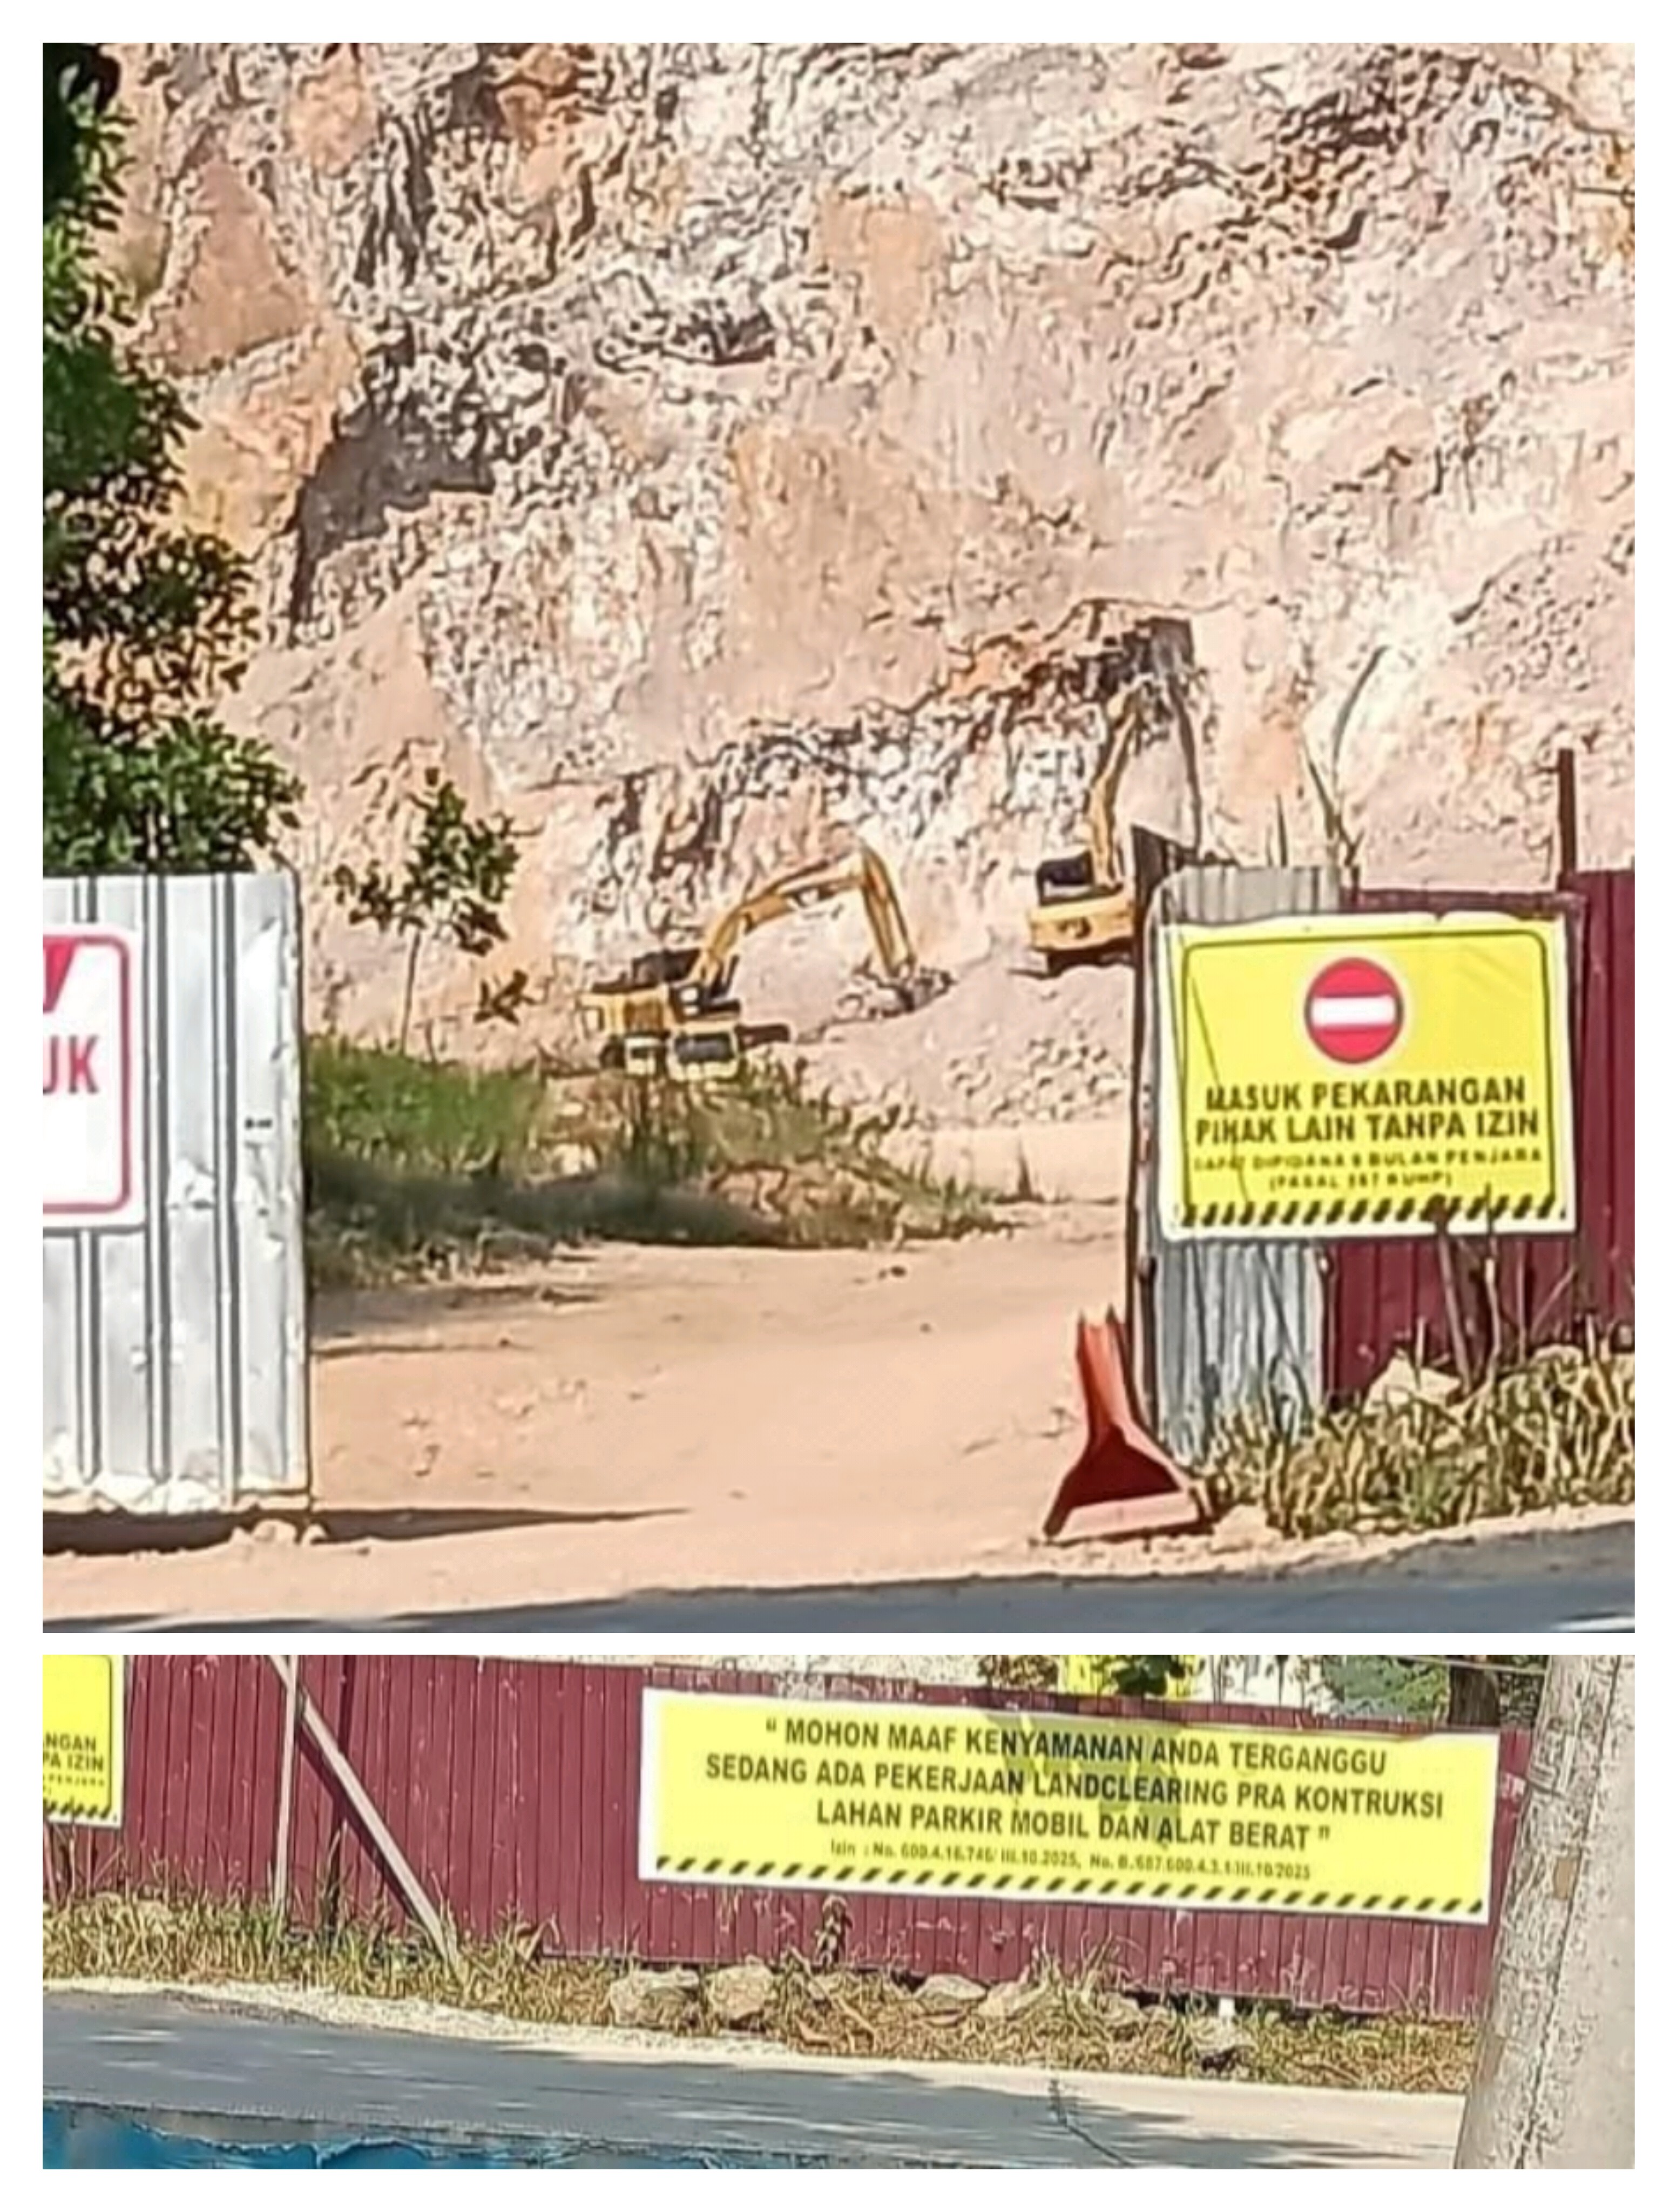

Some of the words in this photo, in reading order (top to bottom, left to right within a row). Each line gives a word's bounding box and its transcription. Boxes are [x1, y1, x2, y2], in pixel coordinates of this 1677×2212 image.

[1206, 1083, 1302, 1111] MASUK
[1311, 1076, 1526, 1110] PEKARANGAN
[1195, 1116, 1276, 1146] PIHAK
[1287, 1114, 1355, 1143] LAIN
[1365, 1109, 1467, 1142] TANPA
[1476, 1107, 1539, 1138] IZIN
[43, 1731, 96, 1752] NGAN
[786, 1718, 878, 1748] MOHON
[888, 1722, 957, 1752] MAAF
[965, 1729, 1142, 1762] KENYAMANAN
[1152, 1737, 1219, 1767] ANDA
[1229, 1741, 1386, 1776] TERGANGGU
[67, 1752, 103, 1772] IZIN
[706, 1753, 807, 1784] SEDANG
[816, 1759, 865, 1787] ADA
[875, 1763, 1024, 1795] PEKERJAAN
[1034, 1771, 1227, 1806] LANDCLEARING
[1237, 1782, 1286, 1810] PRA
[1295, 1785, 1443, 1818] KONTRUKSI
[817, 1799, 901, 1829] LAHAN
[910, 1804, 1002, 1834] PARKIR
[1010, 1810, 1088, 1837] MOBIL
[1099, 1815, 1148, 1840] DAN
[1157, 1818, 1220, 1845] ALAT
[1229, 1820, 1309, 1850] BERAT
